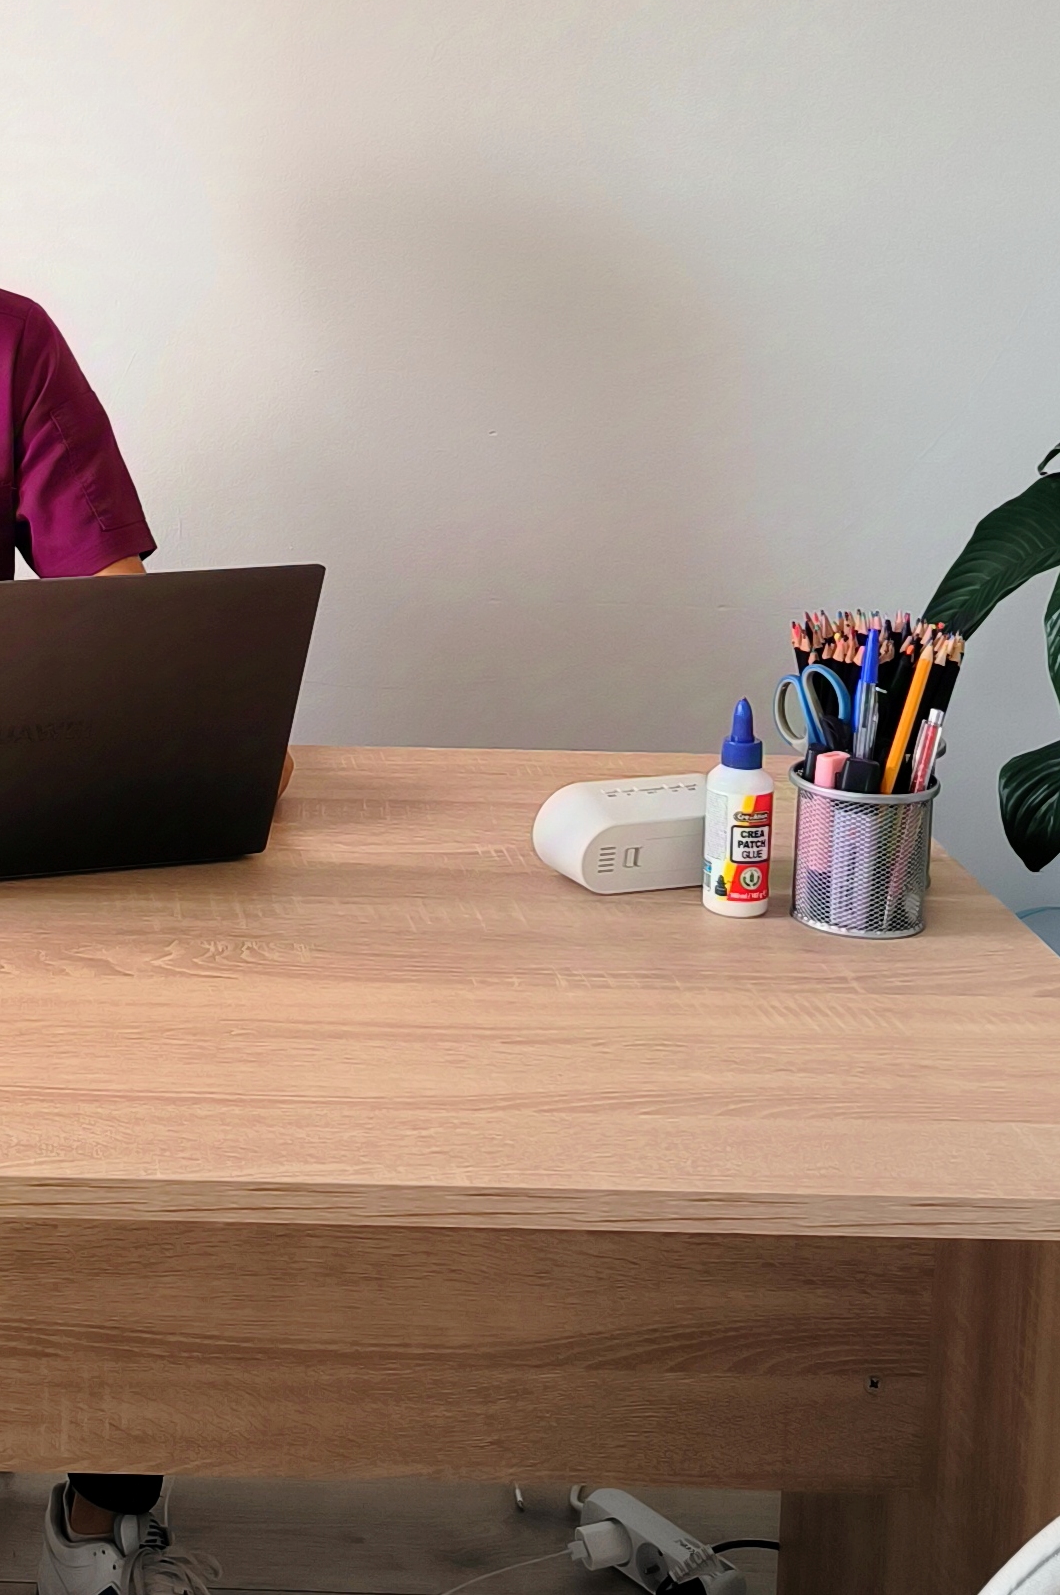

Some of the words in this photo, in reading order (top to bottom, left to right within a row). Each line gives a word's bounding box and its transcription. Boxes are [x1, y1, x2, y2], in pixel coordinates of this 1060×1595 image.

[740, 830, 765, 839] CREA
[737, 840, 766, 849] PATCH
[741, 849, 763, 859] GLUE
